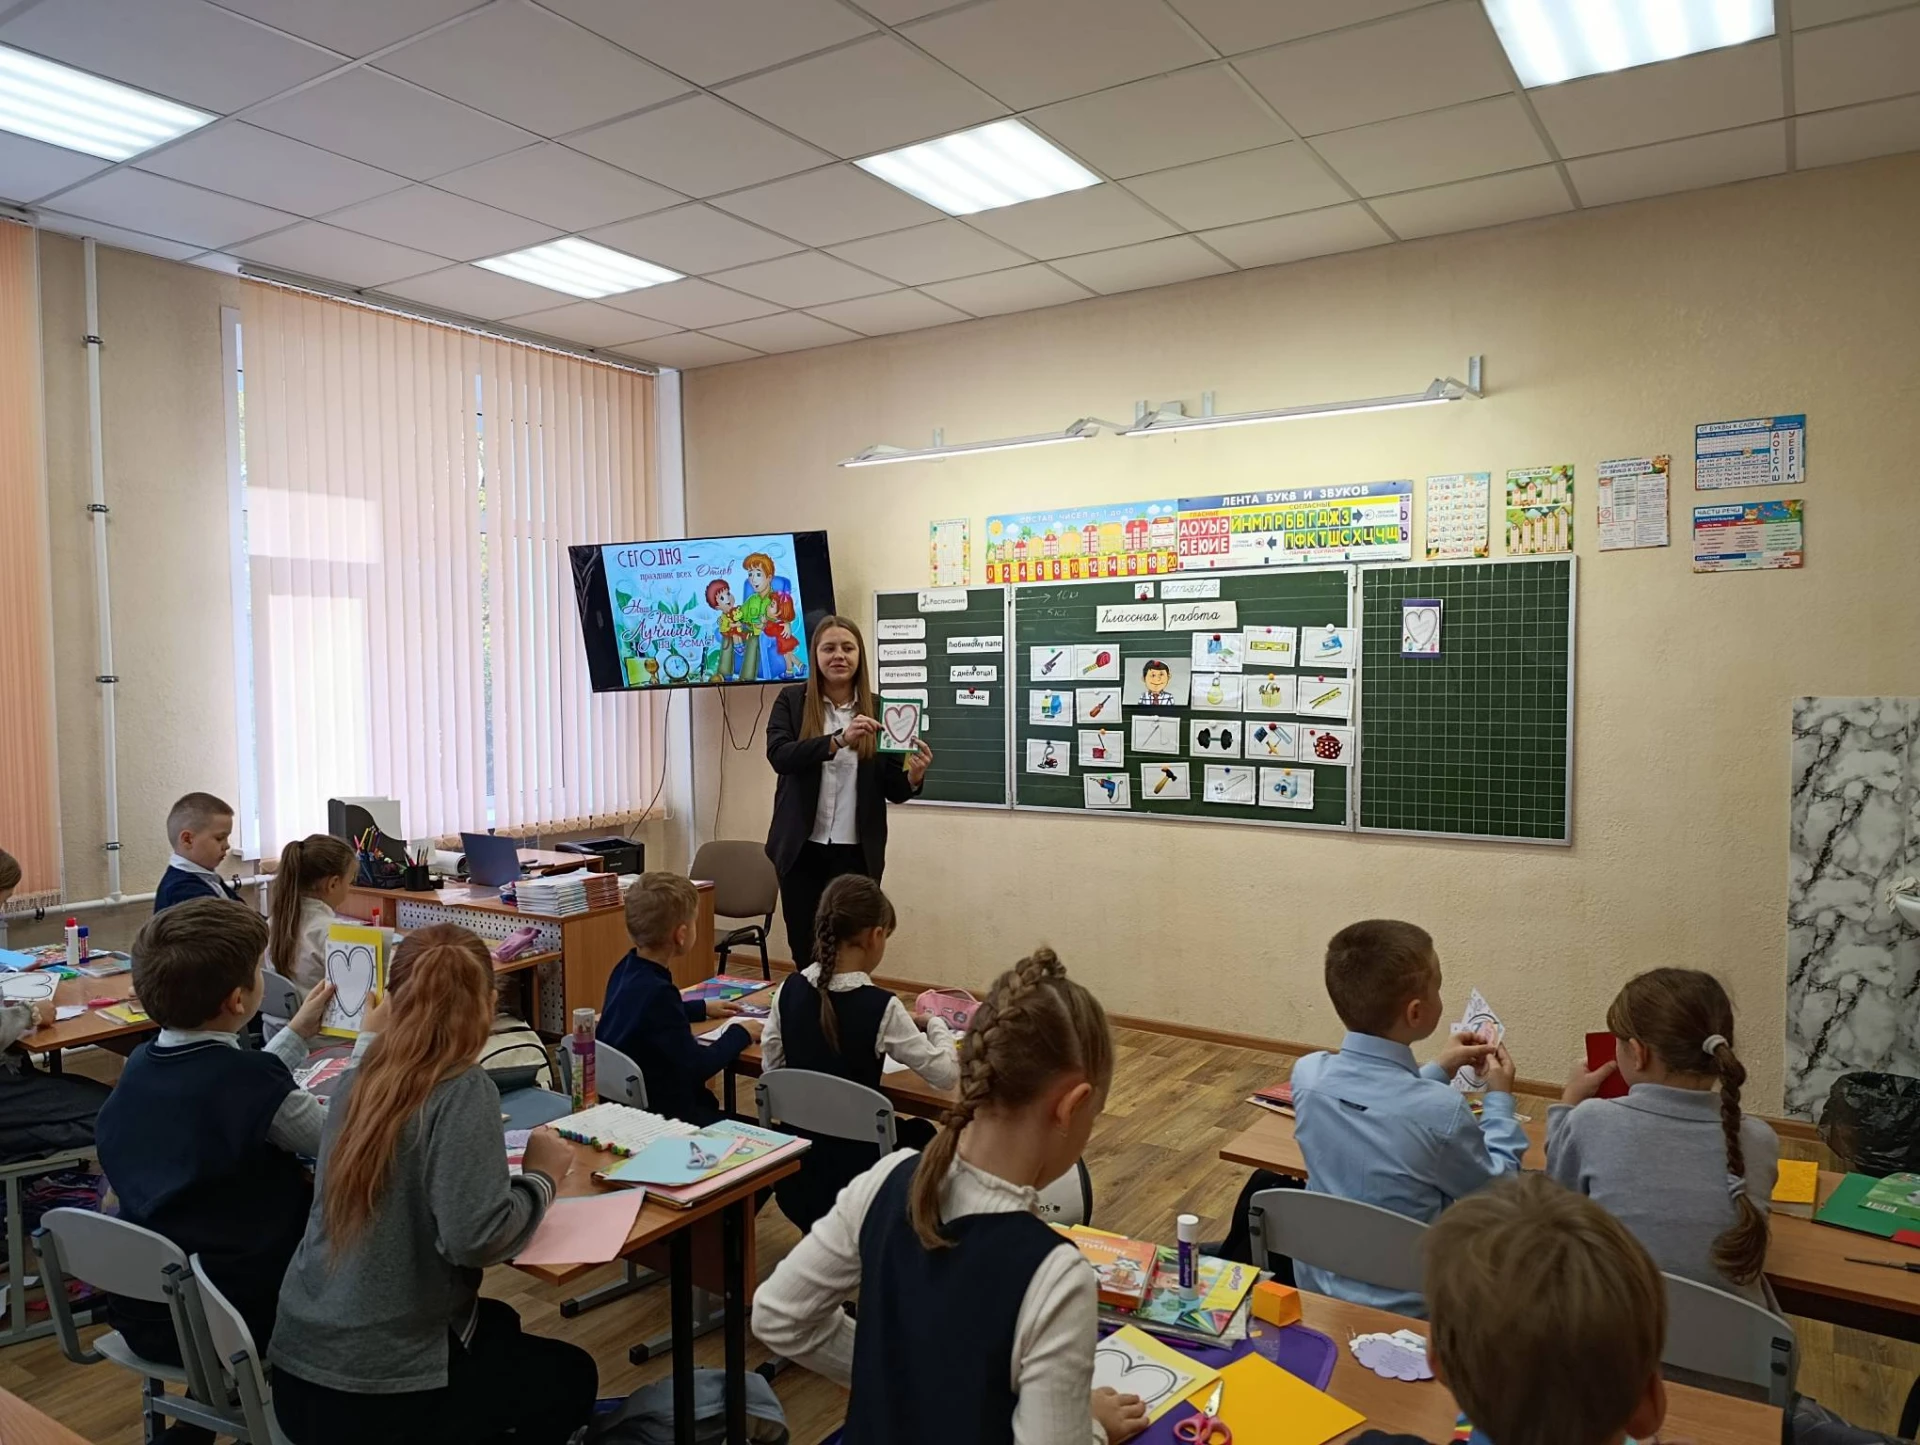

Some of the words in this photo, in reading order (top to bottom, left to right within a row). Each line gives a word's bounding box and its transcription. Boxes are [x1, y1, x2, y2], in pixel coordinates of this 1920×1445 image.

[1709, 424, 1732, 432] БУКВЫ
[1738, 421, 1761, 429] СЛОГУ
[1222, 494, 1260, 507] ЛЕНТА
[1266, 491, 1297, 503] БУКВ
[1304, 490, 1312, 500] И
[1320, 485, 1369, 499] ЗВУКОВ
[1288, 502, 1331, 510] СОГЛАСНЫЕ
[617, 548, 682, 568] СЕГОДНЯ
[640, 572, 674, 582] праздник
[676, 570, 692, 578] всех
[696, 560, 735, 578] Отцов
[988, 567, 993, 579] 0
[1004, 566, 1010, 578] 2
[1020, 565, 1026, 577] 4
[1037, 564, 1043, 576] 6
[1054, 563, 1060, 575] 8
[1071, 562, 1078, 574] 10
[1089, 561, 1098, 572] 12
[1108, 559, 1117, 571] 14
[1128, 558, 1136, 570] 16
[1148, 556, 1157, 568] 18
[1168, 555, 1176, 567] 20
[622, 598, 650, 614] Наш
[1102, 610, 1159, 624] Классная
[1168, 606, 1220, 628] работа
[622, 618, 694, 653] Лучший
[658, 641, 670, 649] на
[883, 648, 907, 656] Русский
[948, 640, 983, 649] Любимому
[957, 670, 974, 678] днём
[976, 669, 993, 678] отца!
